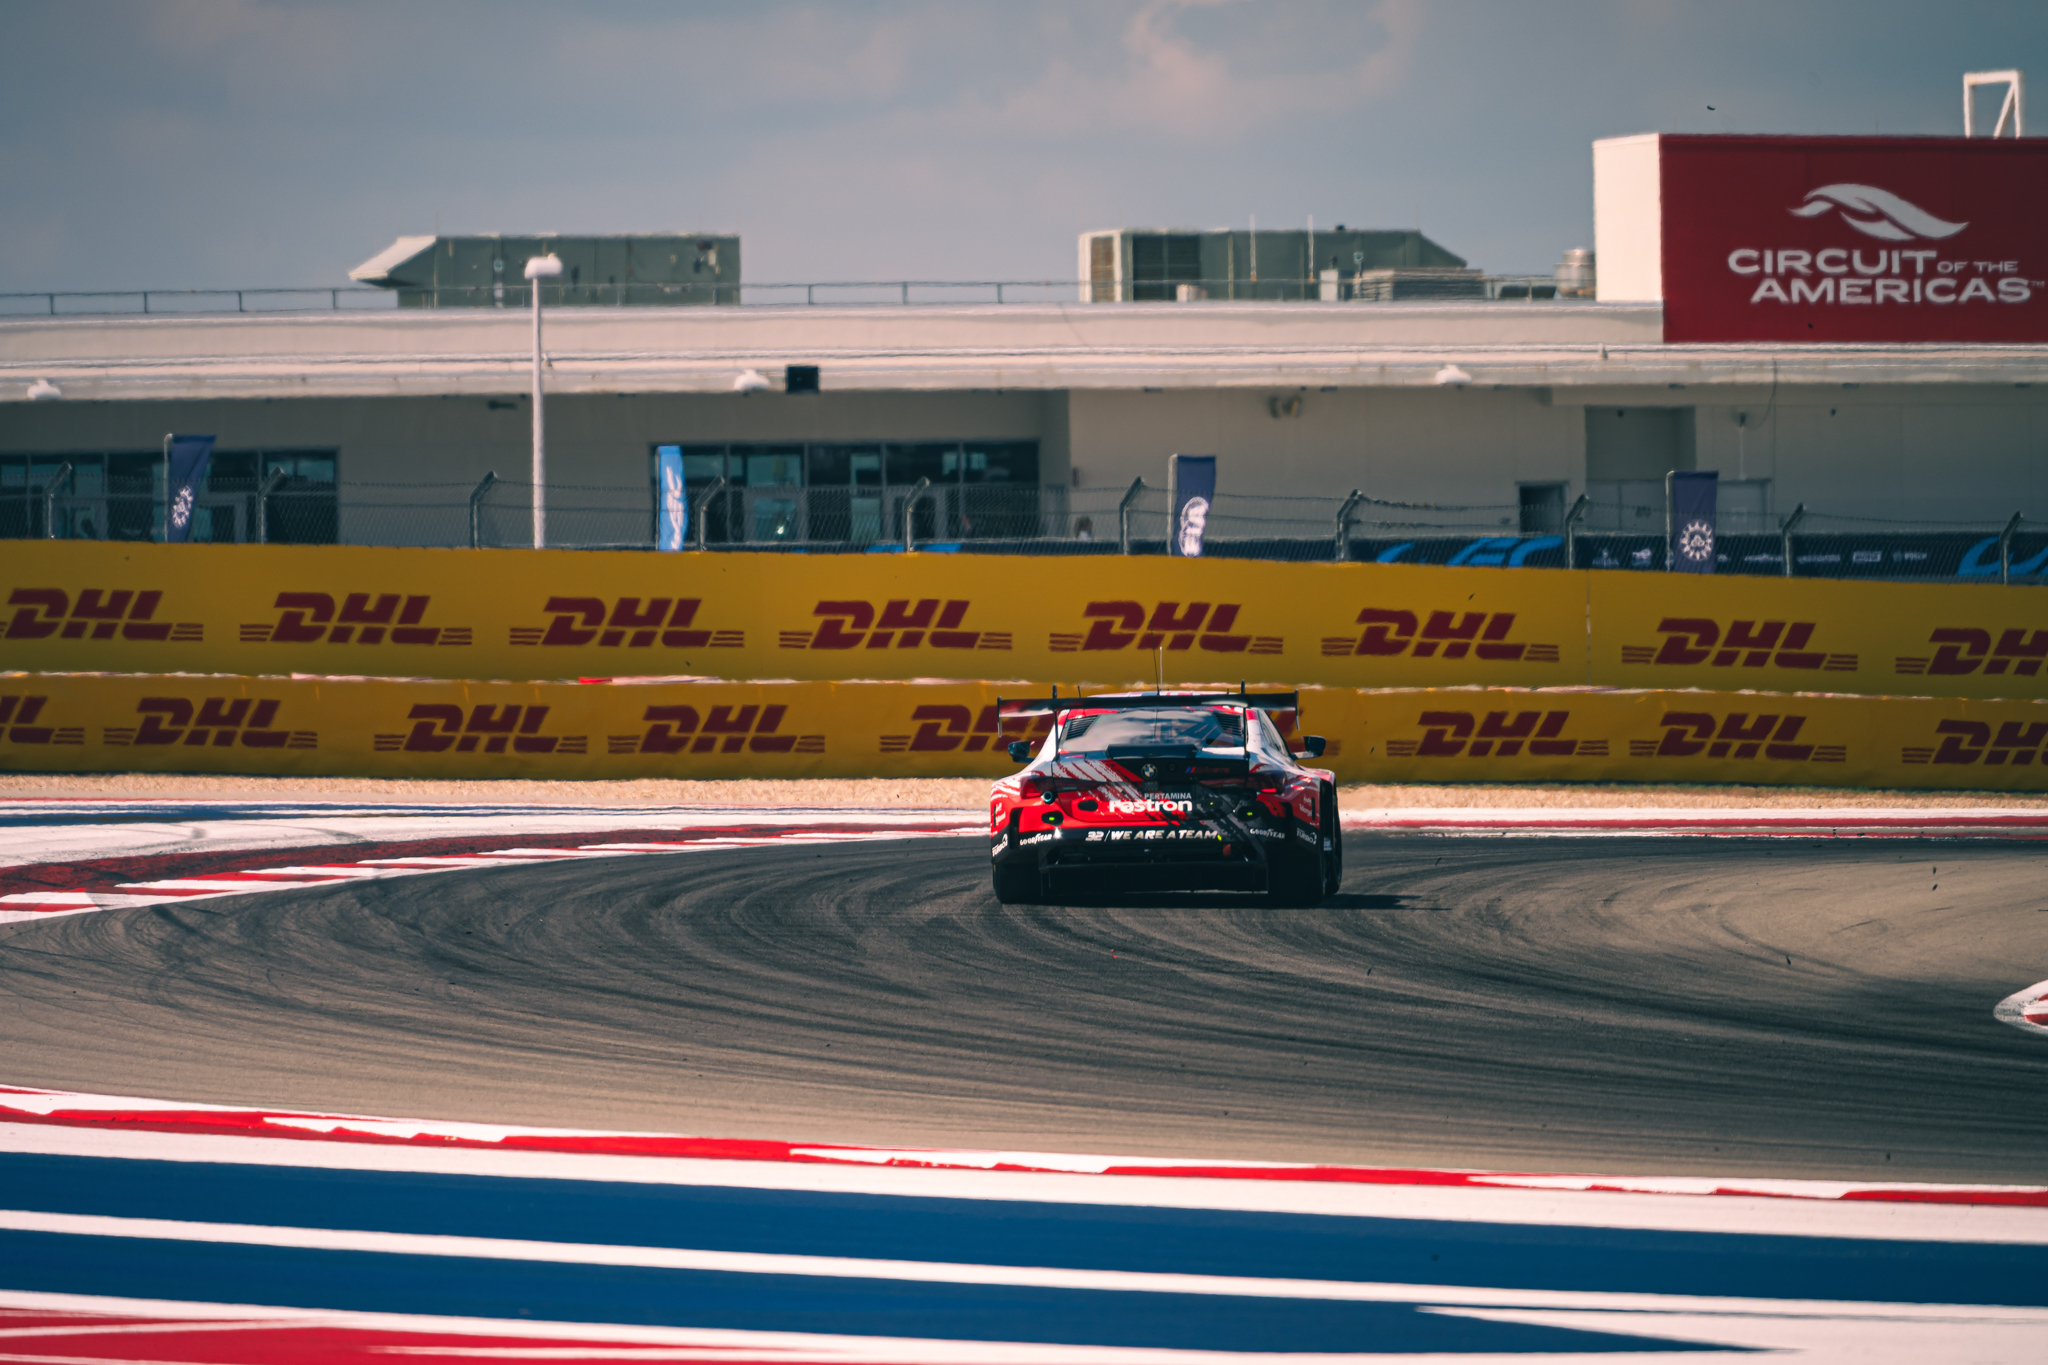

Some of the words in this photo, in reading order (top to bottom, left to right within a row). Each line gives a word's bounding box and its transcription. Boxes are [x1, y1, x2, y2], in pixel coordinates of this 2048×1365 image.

[1728, 248, 1937, 275] CIRCUIT
[1937, 261, 1967, 273] OF
[1973, 261, 2018, 273] THE
[1750, 277, 2031, 304] AMERICAS
[7, 590, 170, 639] DHL
[273, 593, 438, 644] DHL
[544, 597, 710, 647] DHL
[813, 601, 979, 648] DHL
[1084, 602, 1248, 651] DHL
[1358, 609, 1523, 659] DHL
[1657, 619, 1824, 669] DHL
[1928, 627, 2048, 676] DH
[136, 698, 287, 746] DHL
[406, 704, 557, 752] DHL
[642, 706, 794, 752] DHL
[1418, 711, 1575, 756] DHL
[1659, 713, 1812, 760] DHL
[1932, 719, 2048, 765] DH
[1109, 799, 1193, 813] Fastron
[1144, 792, 1192, 800] PERTAMINA
[1134, 830, 1165, 840] ARE
[1166, 830, 1176, 840] A
[1178, 830, 1218, 840] TEAM
[1250, 828, 1286, 839] GOODYEAR
